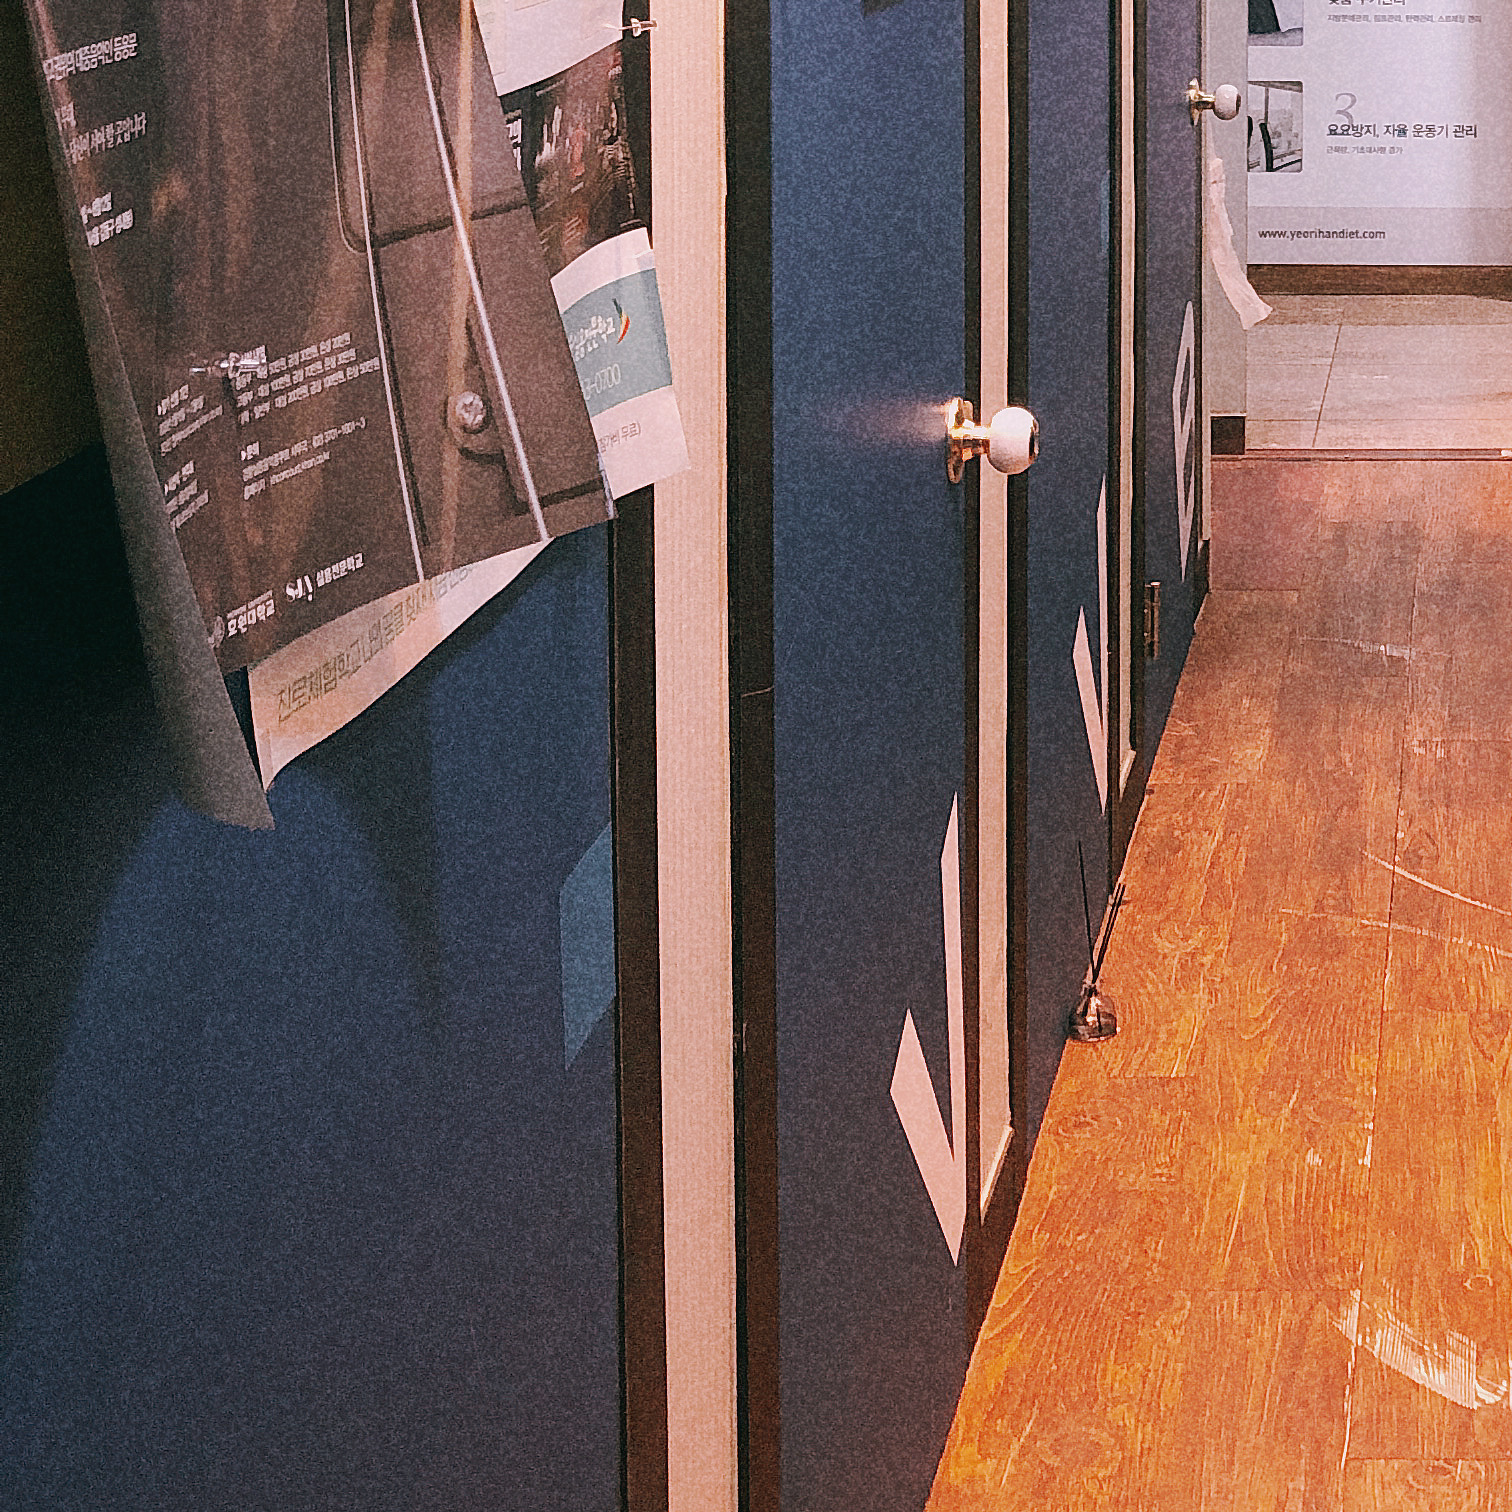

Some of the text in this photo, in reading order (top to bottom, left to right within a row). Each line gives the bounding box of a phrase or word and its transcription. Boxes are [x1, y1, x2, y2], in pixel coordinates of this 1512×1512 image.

[113, 32, 138, 62] 등용문
[1327, 124, 1478, 140] 요요방지, 자율 운동기 관리
